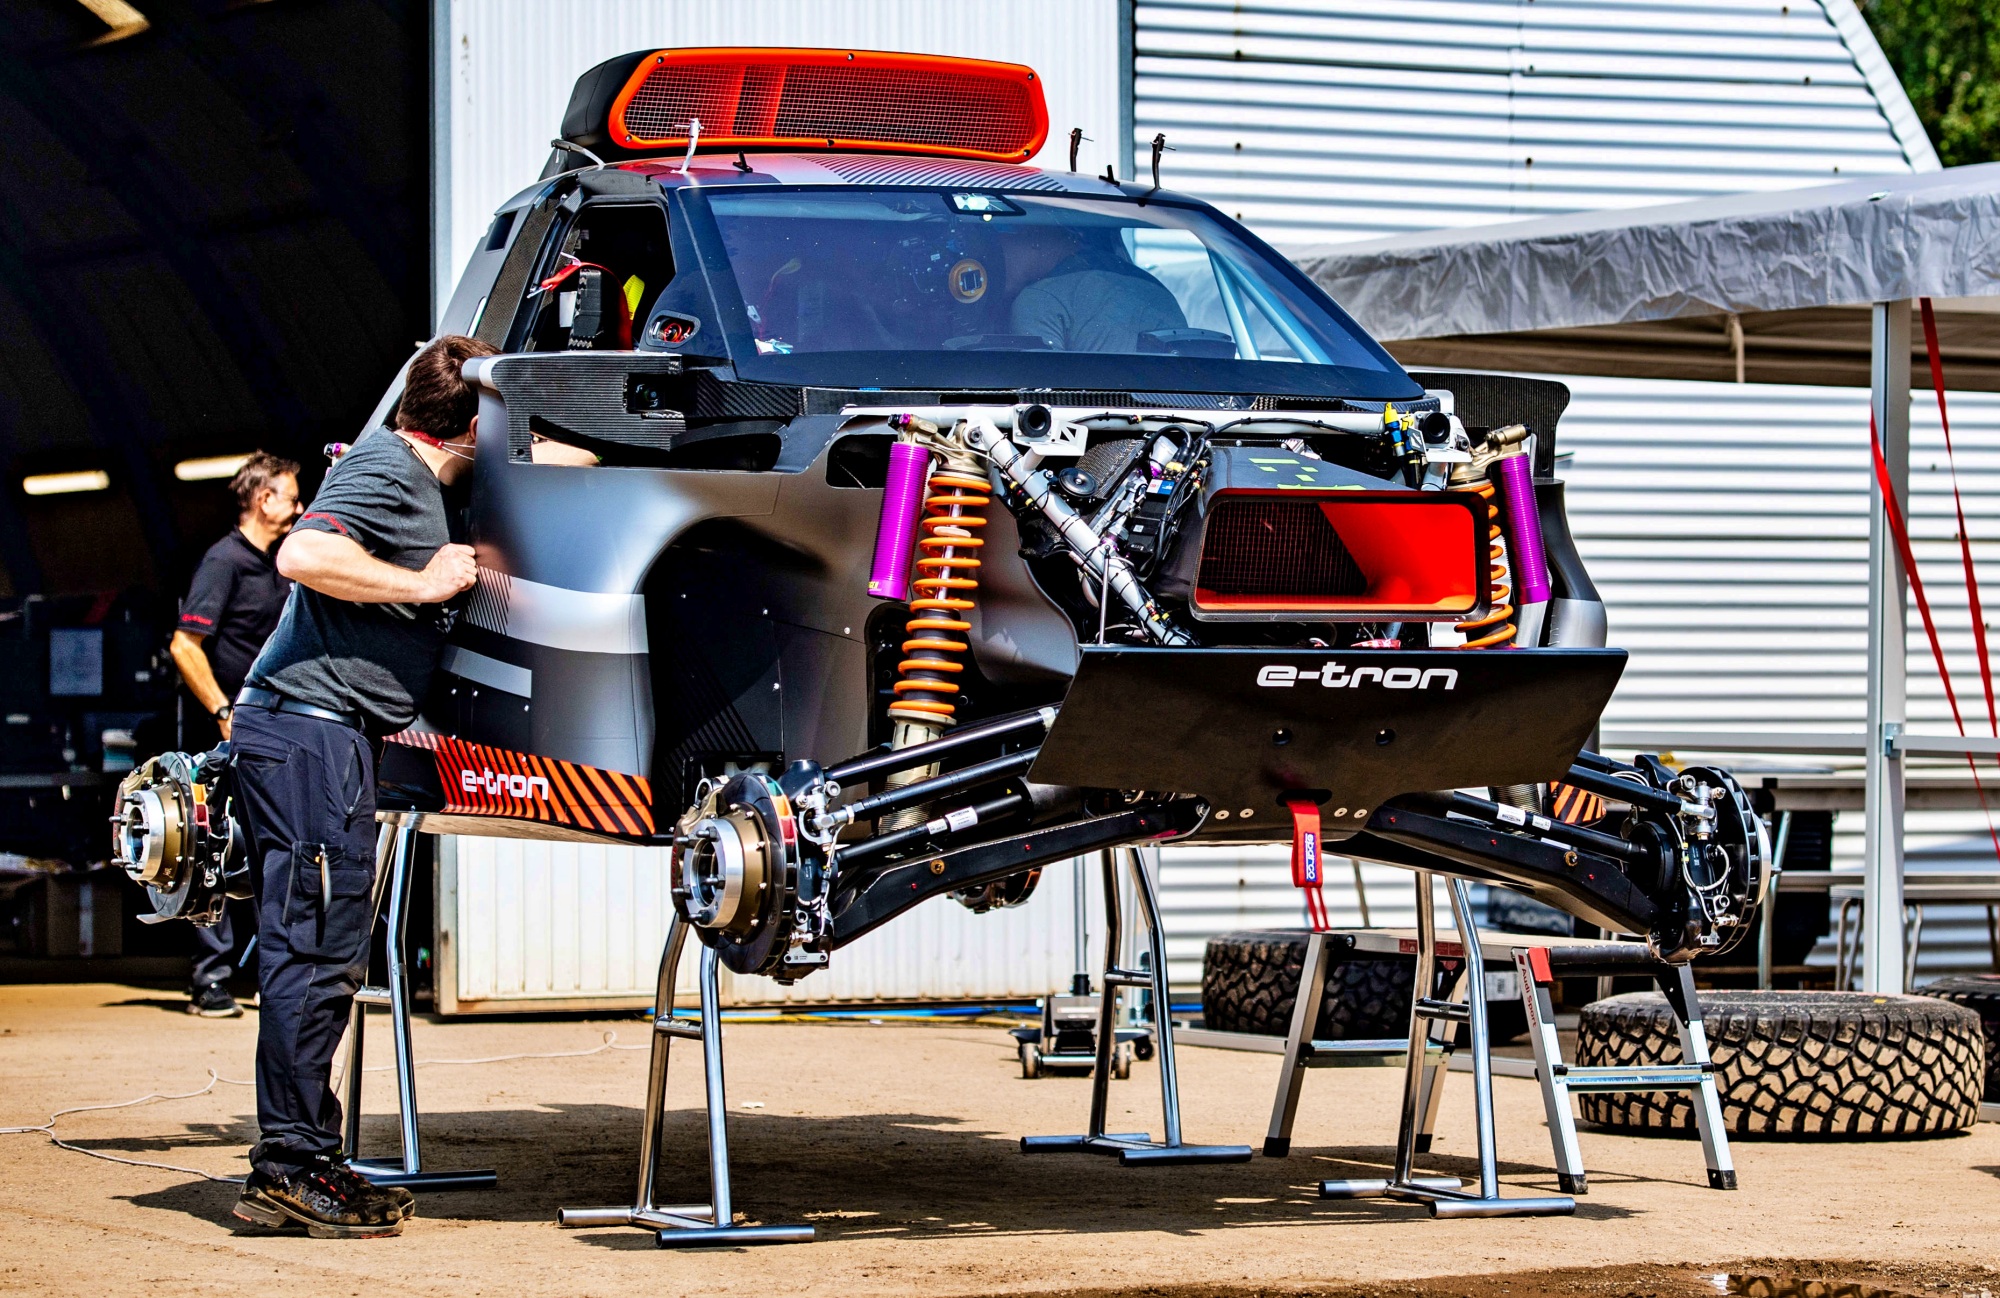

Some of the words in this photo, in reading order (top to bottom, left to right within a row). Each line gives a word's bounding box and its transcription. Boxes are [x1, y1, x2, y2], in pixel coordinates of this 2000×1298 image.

[1256, 661, 1459, 690] e-tron
[461, 762, 549, 801] e-tron
[1521, 968, 1531, 993] Audi
[1527, 995, 1537, 1028] Sport
